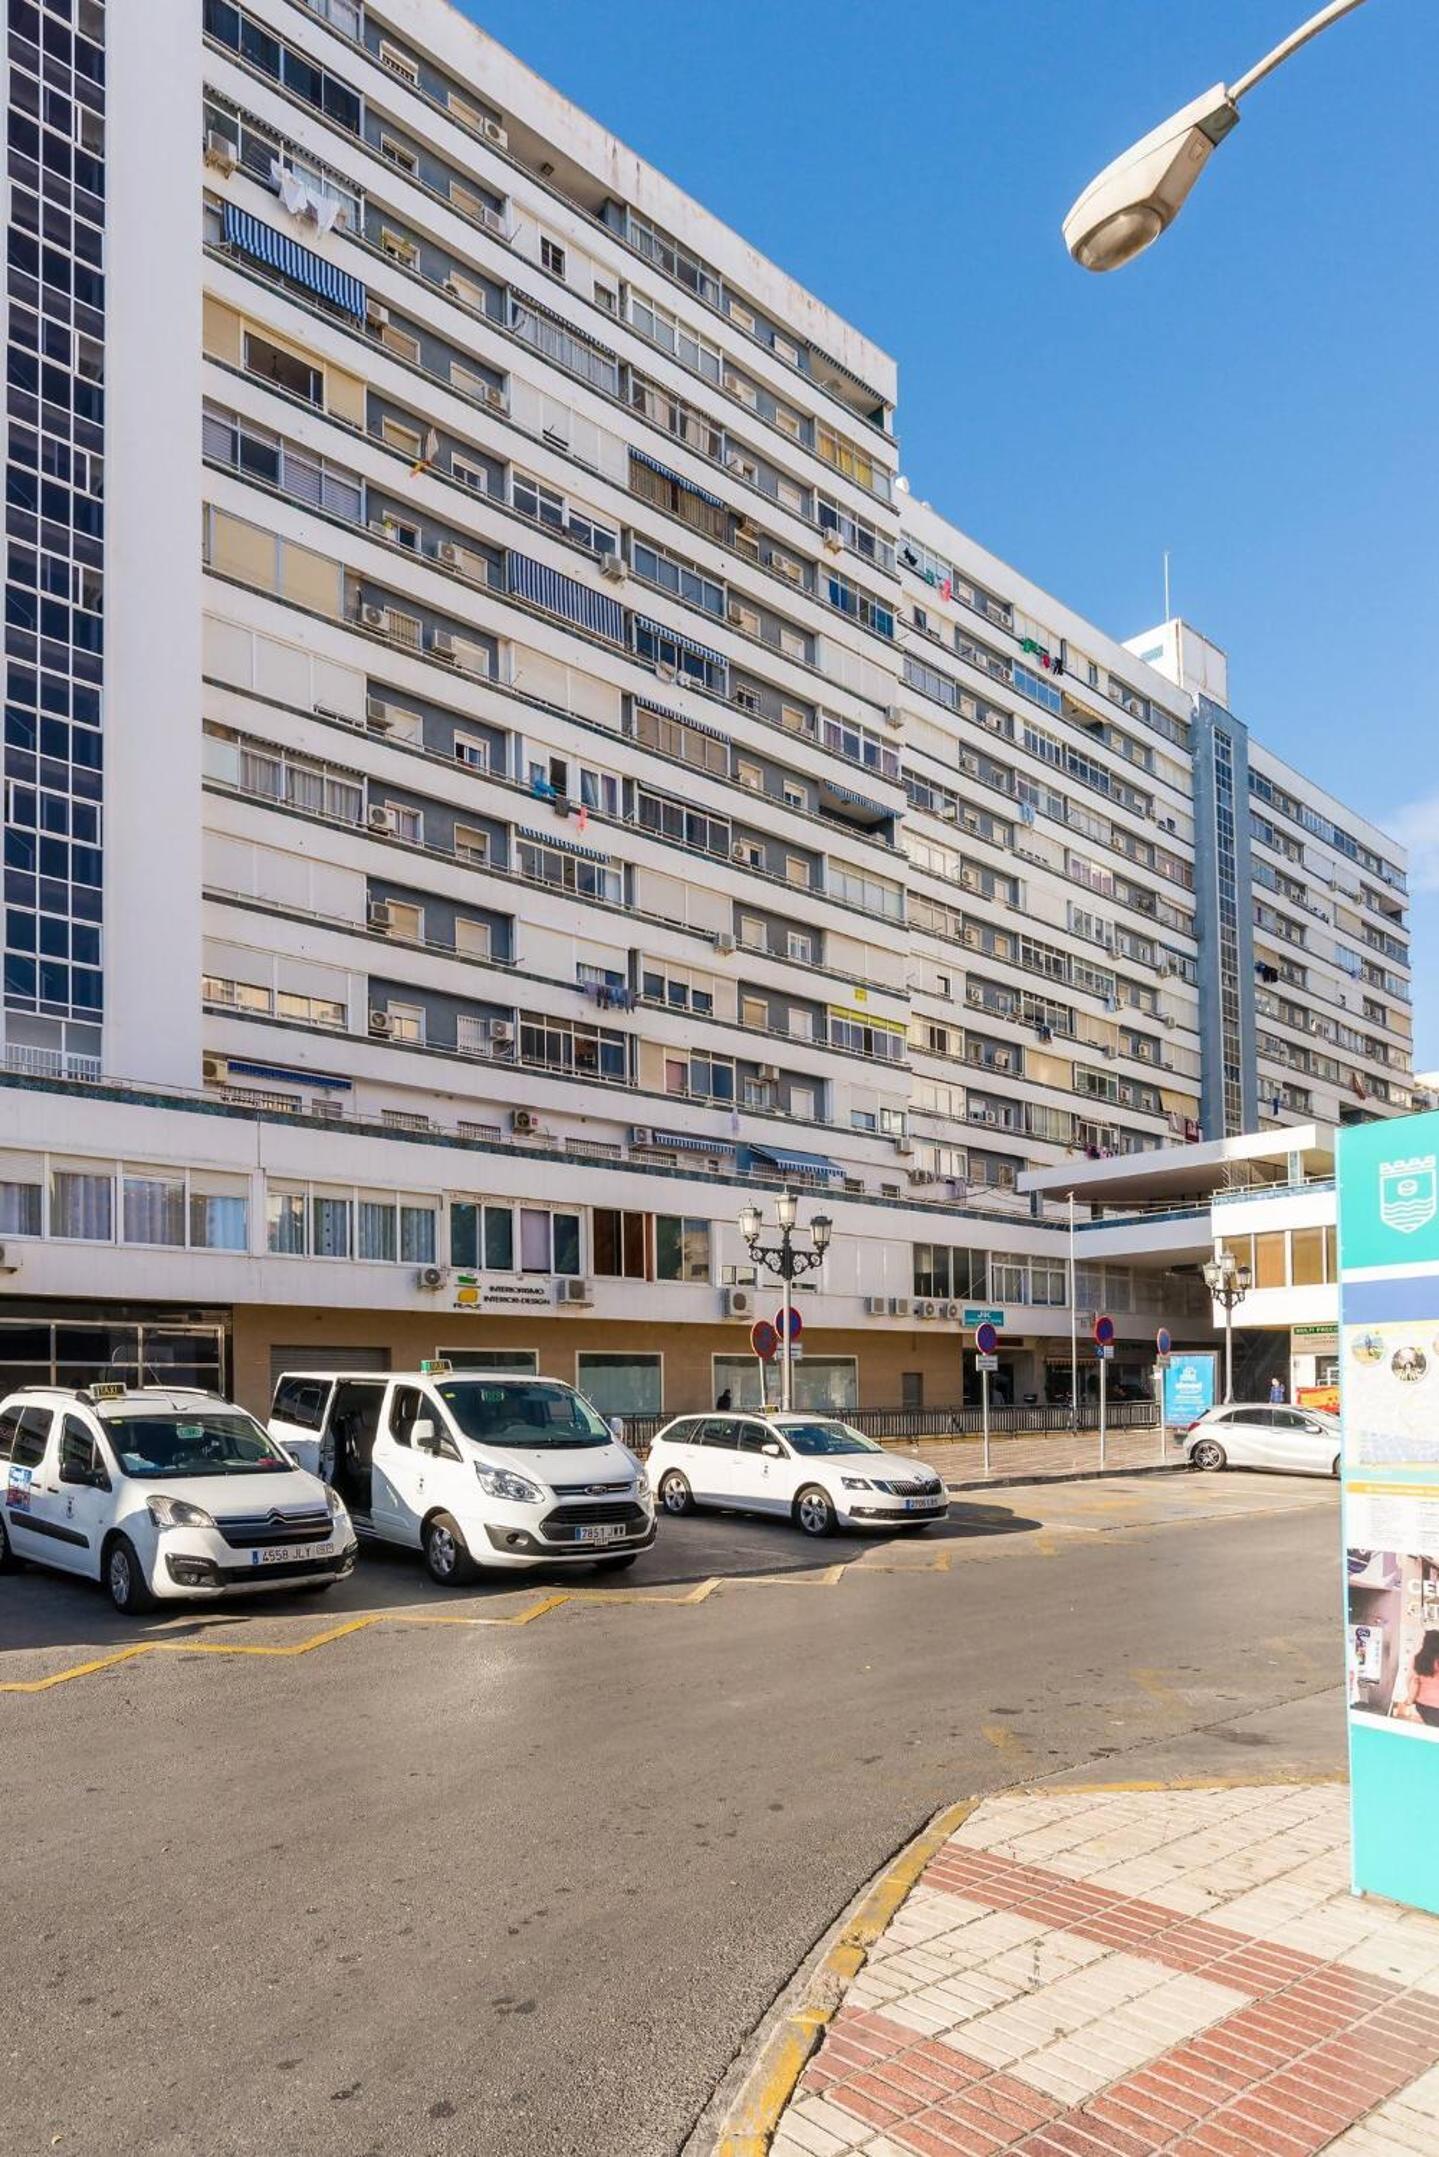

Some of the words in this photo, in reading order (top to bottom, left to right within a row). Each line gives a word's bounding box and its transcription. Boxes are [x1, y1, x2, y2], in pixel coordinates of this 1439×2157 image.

[101, 1386, 118, 1395] TAXI
[262, 1549, 289, 1562] 4558
[294, 1545, 312, 1559] JLY
